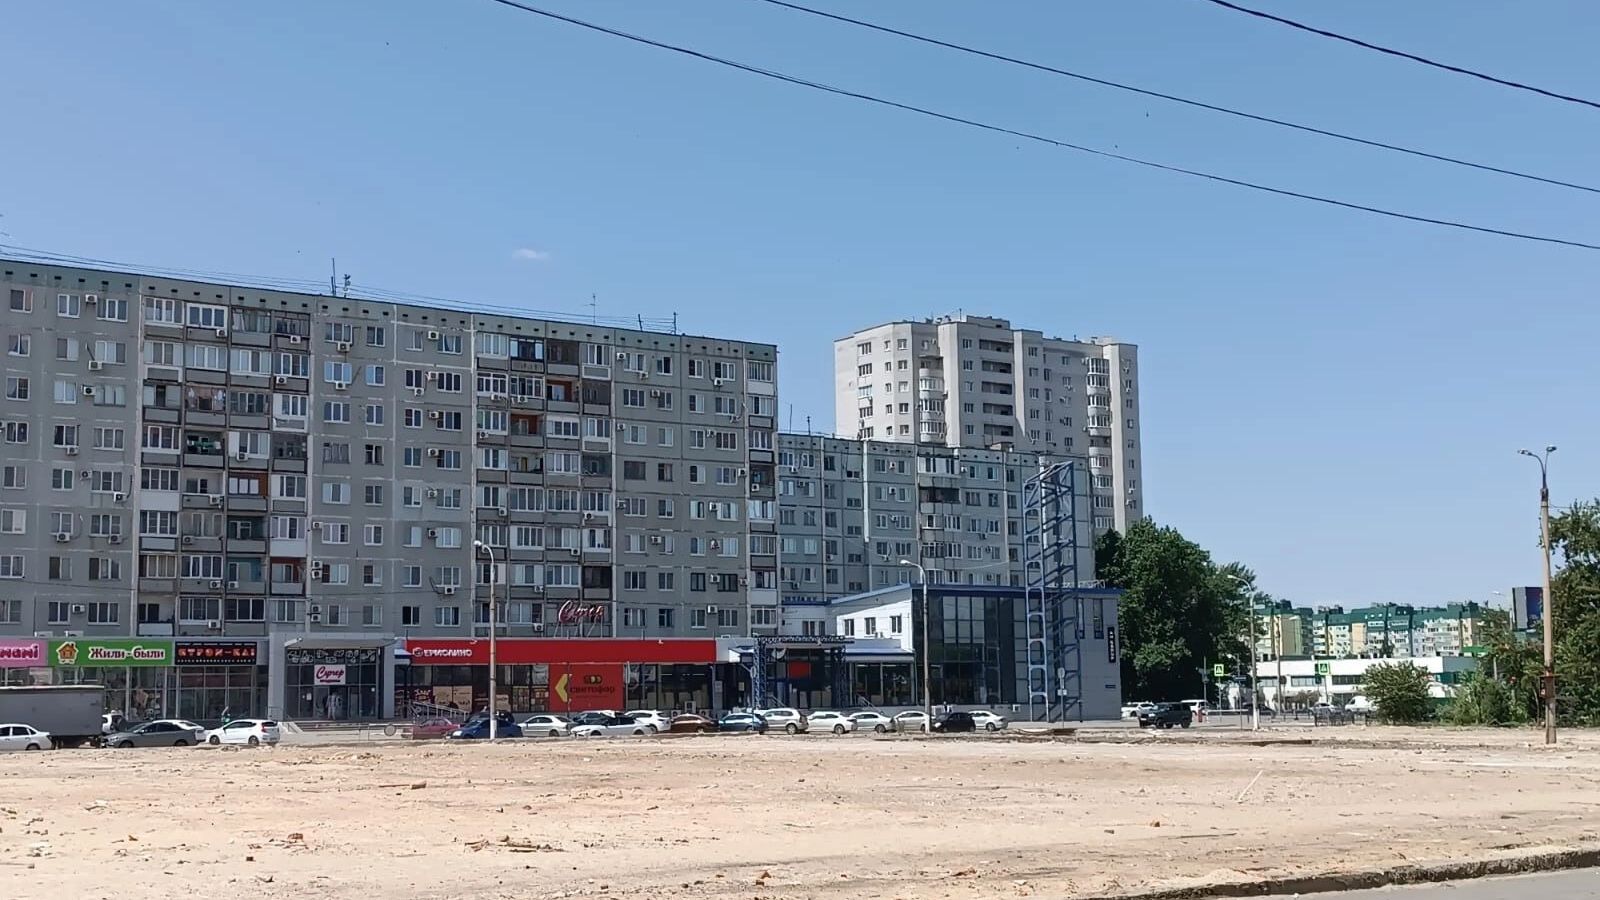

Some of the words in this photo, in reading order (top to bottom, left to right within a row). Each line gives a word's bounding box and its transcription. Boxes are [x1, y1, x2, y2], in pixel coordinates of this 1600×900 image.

[90, 646, 164, 659] Жили-были
[424, 649, 472, 657] ЕРМОЛИНО
[316, 665, 345, 679] Супер
